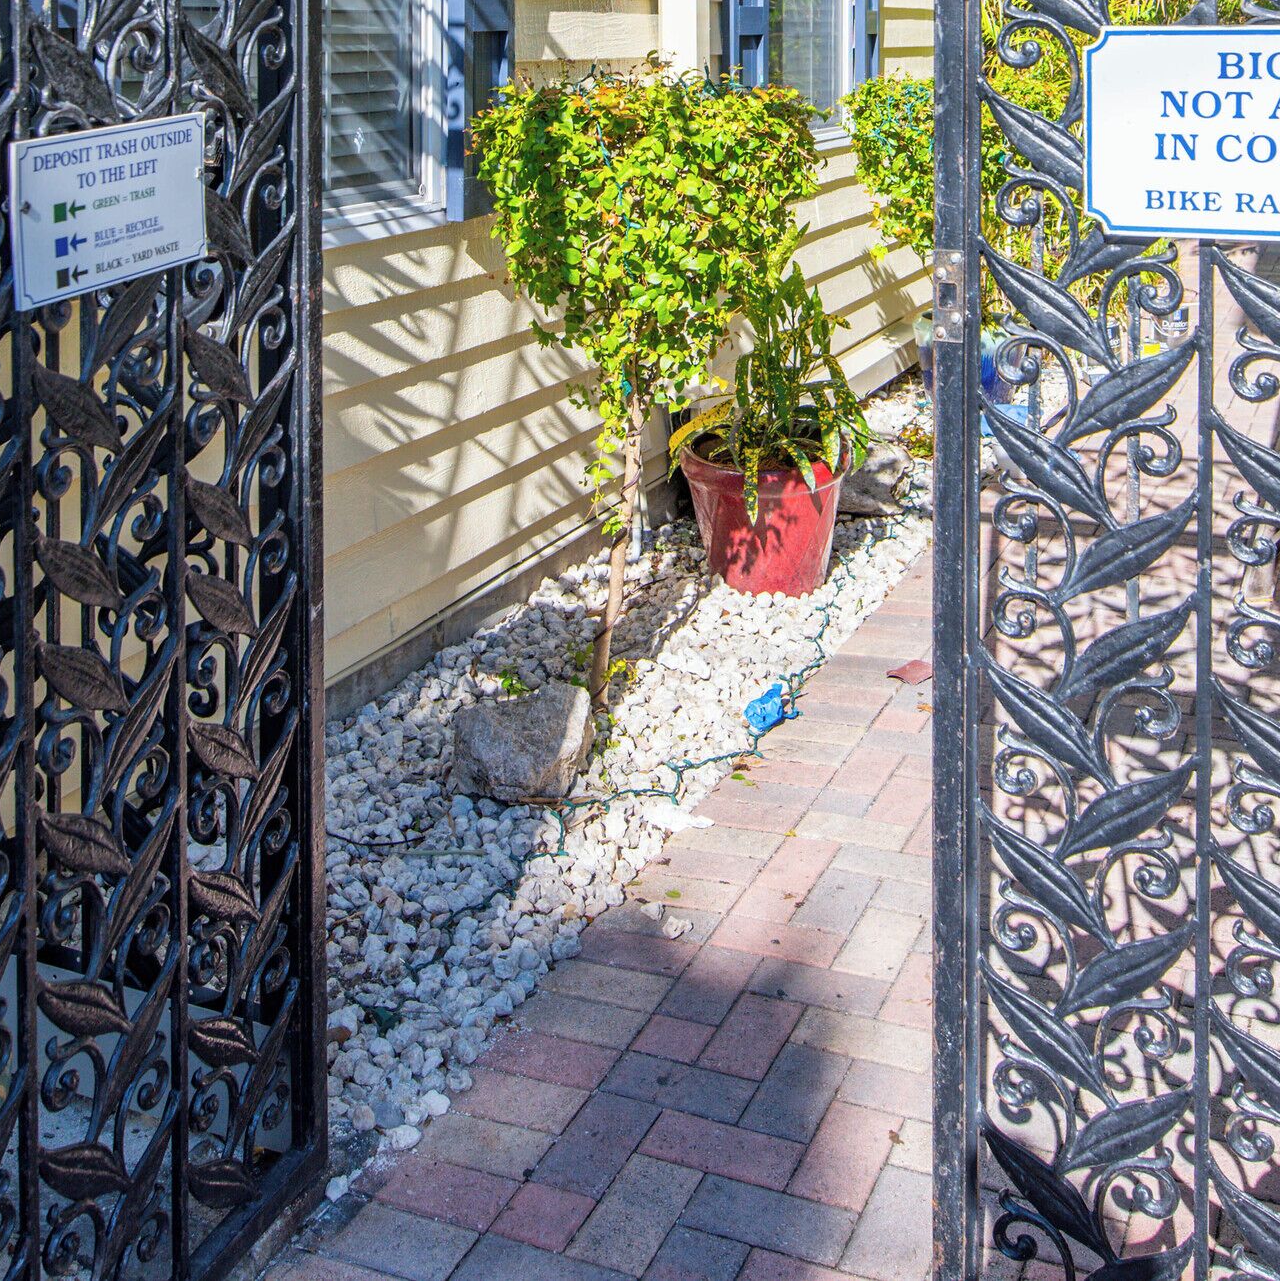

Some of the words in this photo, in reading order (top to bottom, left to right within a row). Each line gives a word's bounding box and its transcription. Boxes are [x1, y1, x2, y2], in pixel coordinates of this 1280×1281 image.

[1160, 90, 1254, 119] NOT
[32, 146, 93, 173] DEPOSIT
[95, 138, 138, 160] TRASH
[141, 128, 193, 152] OUTSIDE
[1153, 132, 1199, 162] IN
[76, 171, 96, 189] TO
[99, 165, 126, 185] THE
[129, 158, 158, 179] LEFT
[92, 195, 120, 210] GREEN
[130, 186, 156, 202] TRASH
[1145, 189, 1222, 213] BIKE
[94, 227, 116, 241] BLUE
[125, 215, 160, 234] RECYCLE
[95, 256, 123, 274] BLACK
[131, 249, 153, 263] YARD
[154, 241, 180, 256] WASTE
